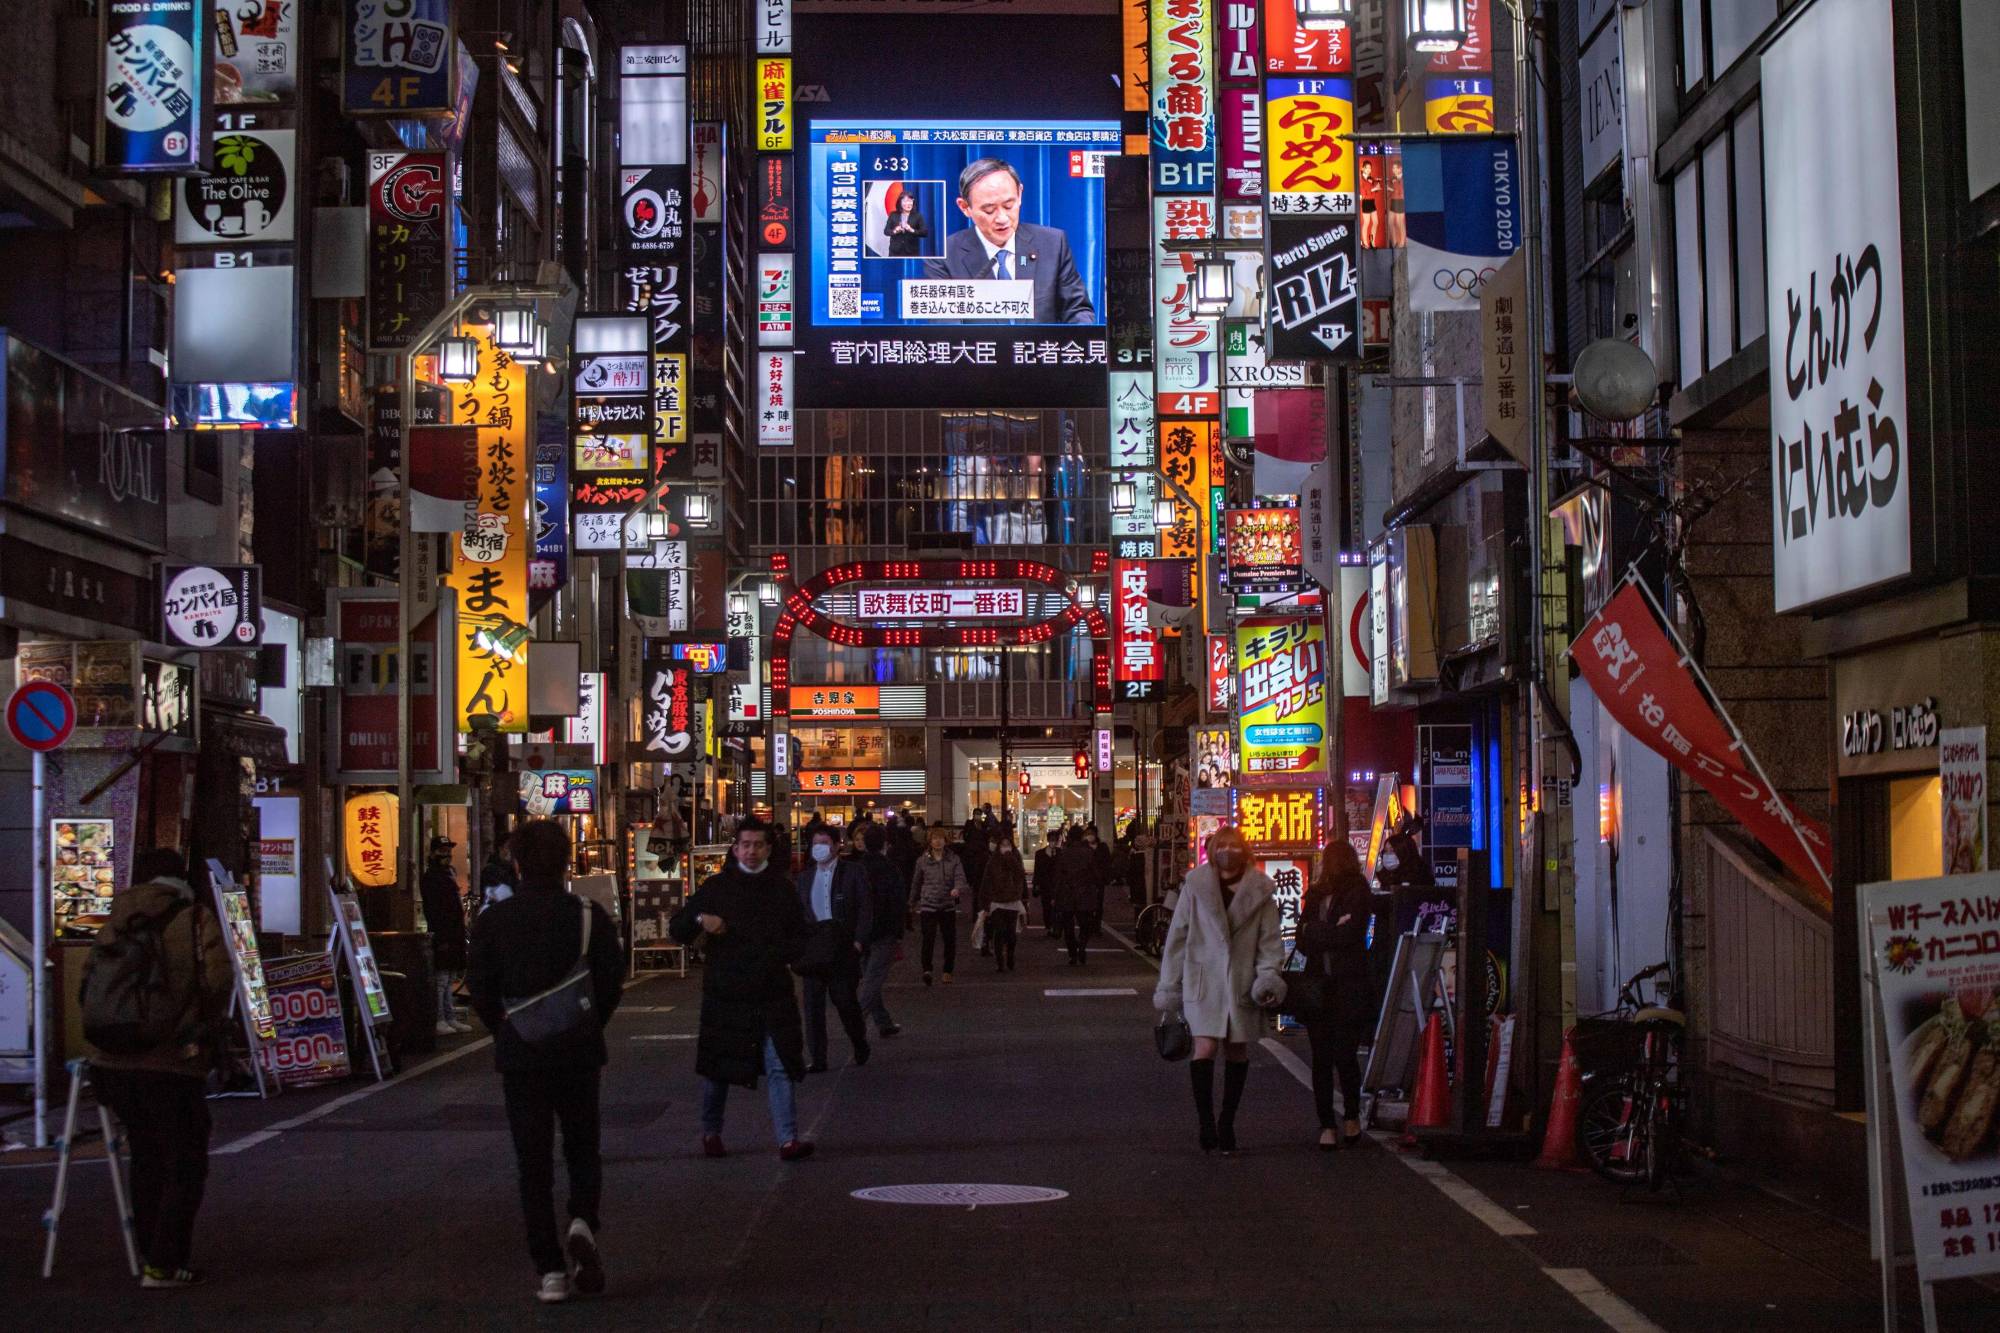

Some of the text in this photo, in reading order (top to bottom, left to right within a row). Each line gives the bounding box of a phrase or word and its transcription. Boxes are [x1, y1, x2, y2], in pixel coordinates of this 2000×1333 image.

[112, 3, 141, 13] FOOD
[153, 2, 191, 12] DRINKS
[144, 39, 184, 81] 新宿酒場
[1270, 59, 1285, 70] 2F
[109, 32, 192, 120] カンパイ屋
[372, 76, 421, 107] 4F
[1297, 81, 1326, 94] 1F
[763, 62, 786, 134] 麻雀ブル
[218, 114, 256, 129] 1F
[167, 138, 186, 151] B1
[766, 137, 783, 148] 6F
[1279, 100, 1343, 190] らーめん
[372, 156, 394, 169] 3F
[874, 157, 909, 171] 6:33
[625, 174, 639, 185] 4F
[1160, 163, 1213, 185] B1F
[201, 185, 270, 200] The Olive
[1493, 150, 1515, 251] TOKYO 2020
[1272, 195, 1352, 213] 博多天神
[661, 226, 682, 238] 酒場
[768, 228, 783, 239] 4F
[1273, 224, 1348, 270] Party Space
[214, 252, 254, 268] B1
[389, 224, 411, 333] カリーナ
[910, 285, 975, 298] 核兵器保有国を
[1275, 254, 1350, 328] RIZ
[764, 303, 787, 311] たばこ
[910, 301, 1030, 315] 巻き込んで進めること不可欠
[766, 323, 785, 331] ATM
[1786, 242, 1882, 402] とんかつ
[1231, 331, 1243, 344] 肉
[1321, 327, 1343, 339] B1
[831, 341, 1106, 364] 菅内閣総理大臣 記者会見
[1117, 348, 1151, 363] 3F
[1494, 296, 1515, 419] 劇場通り一番街
[613, 371, 641, 387] 酔月
[769, 356, 783, 406] お好み焼
[1228, 366, 1302, 382] XROSS
[656, 358, 681, 412] 麻雀
[1175, 395, 1208, 413] 4F
[578, 404, 646, 421] 日本人セラピスト
[763, 410, 789, 421] 本陣
[656, 416, 681, 437] 2F
[1779, 376, 1900, 550] にいむら
[488, 436, 516, 511] 水炊き
[1128, 523, 1146, 532] 3F
[1120, 541, 1154, 557] 焼肉
[181, 582, 216, 595] 新宿酒場
[166, 587, 239, 616] カンパイ屋
[863, 592, 1019, 614] 歌舞伎町一番街
[240, 627, 253, 637] B1
[1245, 617, 1309, 660] キラリ
[1244, 643, 1318, 707] 出会い
[1127, 682, 1152, 697] 2F
[813, 691, 855, 705] 吉野家
[1275, 681, 1322, 721] カフェ
[1844, 696, 1938, 756] とんかつ にいむら
[777, 737, 785, 773] 劇場通り
[1100, 731, 1109, 769] 劇場通り
[1249, 758, 1300, 771] 受付3F
[256, 779, 280, 793] B1
[569, 777, 592, 785] フリー
[815, 775, 856, 787] 吉野家
[1239, 792, 1314, 842] 案内所
[358, 806, 385, 876] 鉄なべ餃子
